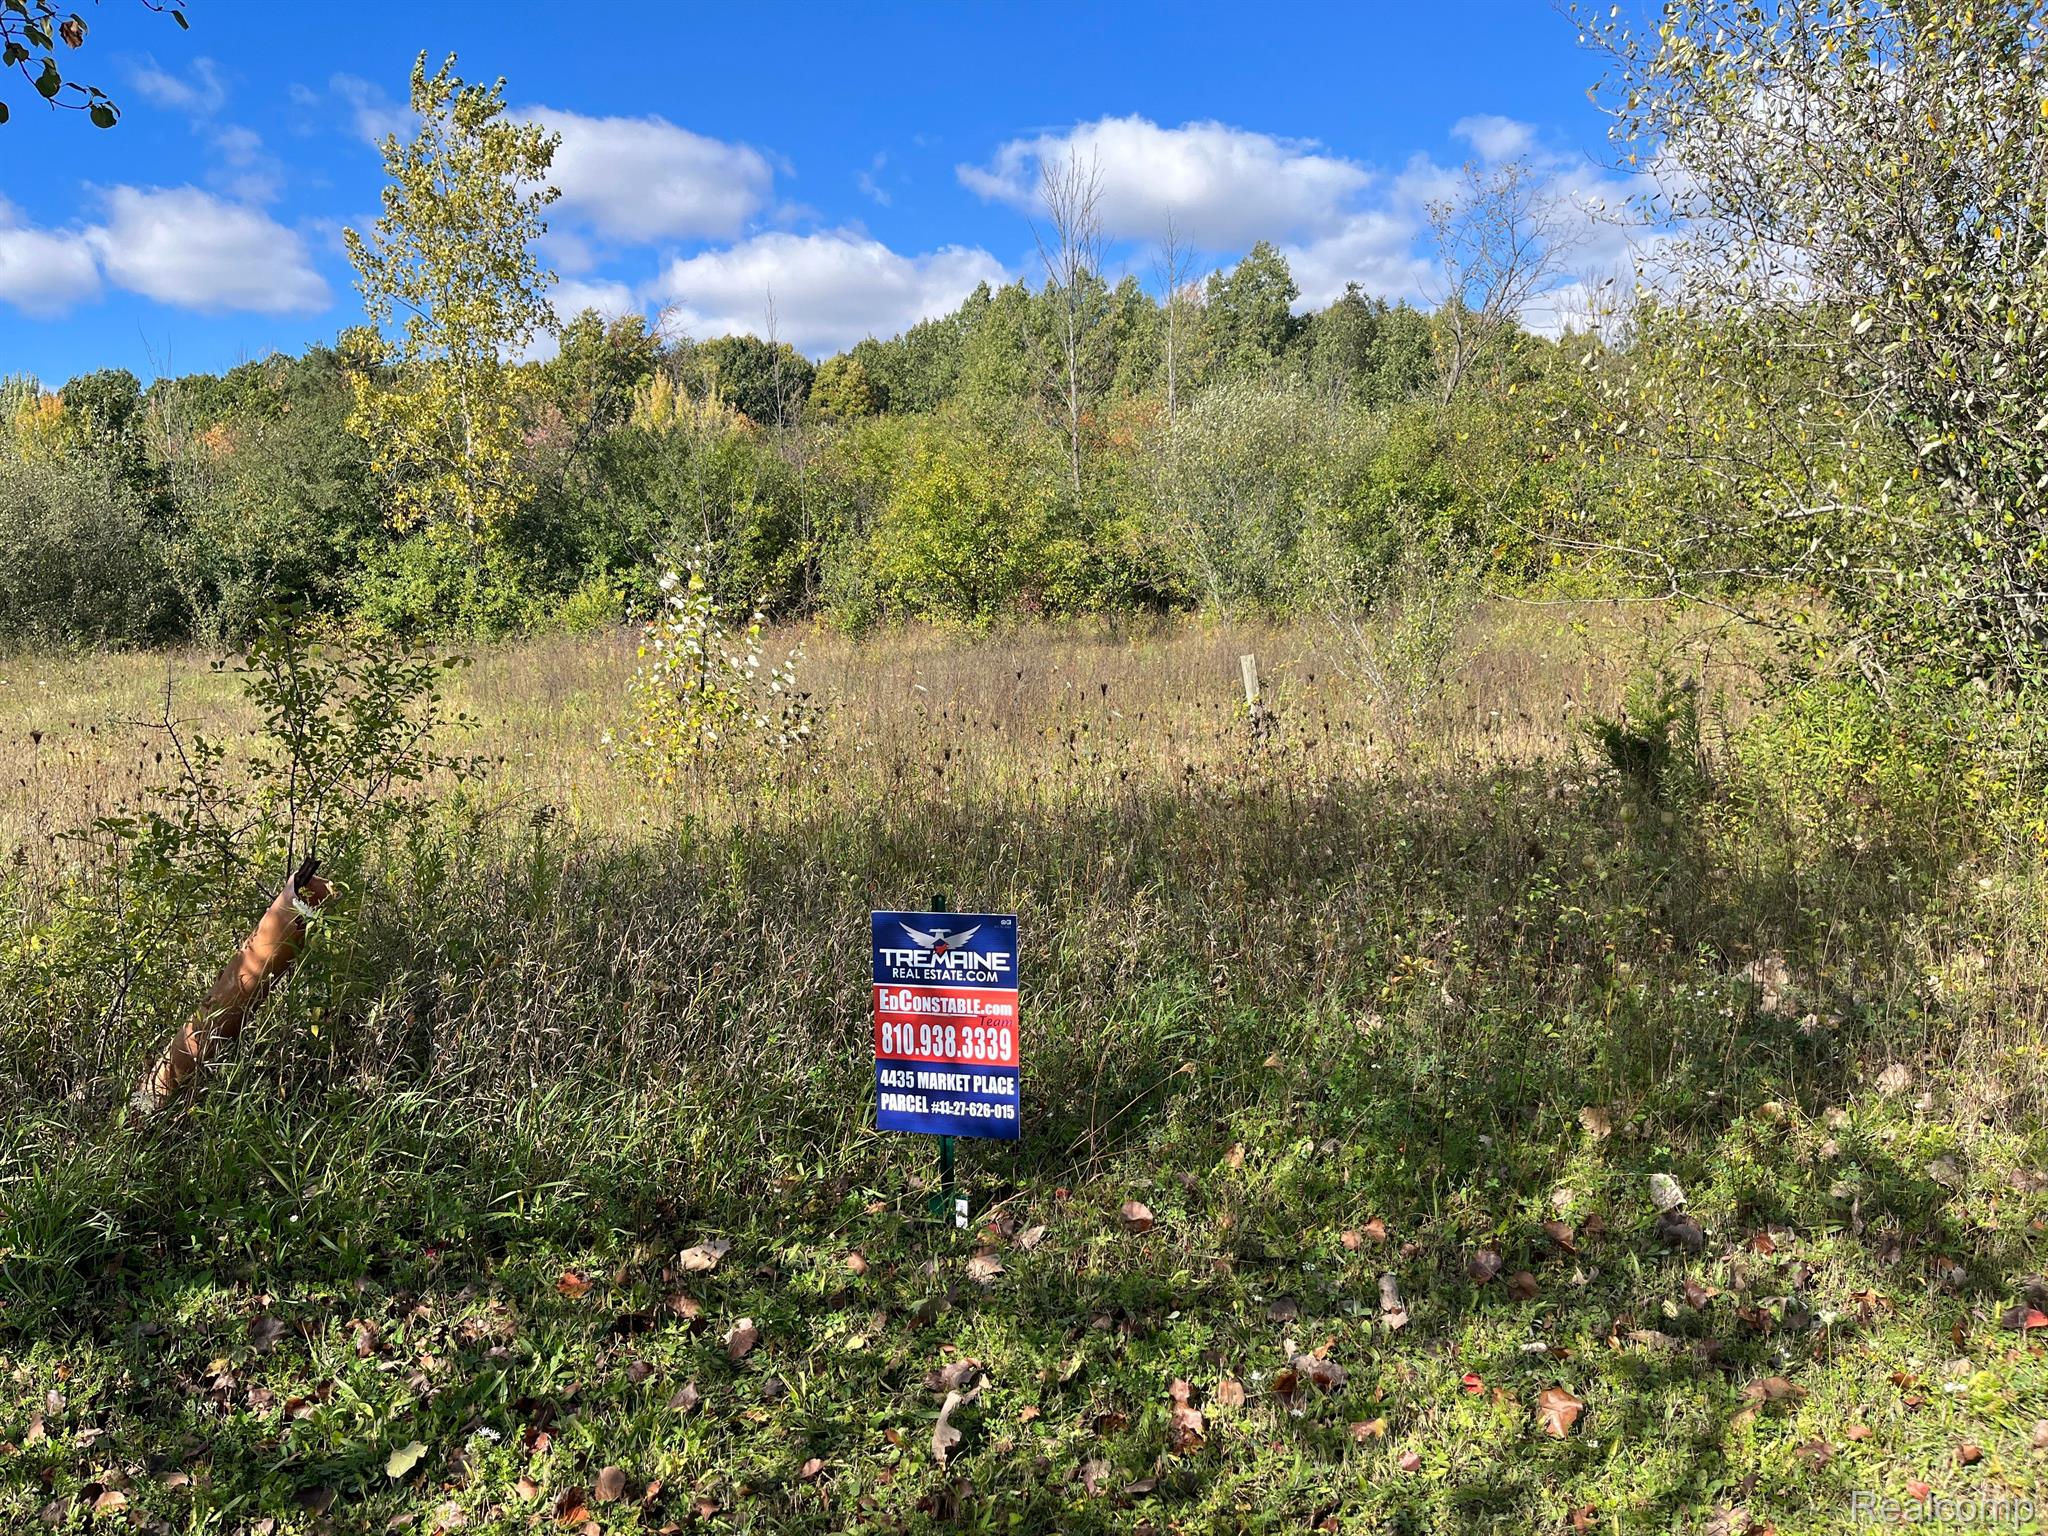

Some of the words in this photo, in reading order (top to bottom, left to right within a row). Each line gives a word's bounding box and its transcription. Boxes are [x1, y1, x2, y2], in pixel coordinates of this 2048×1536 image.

[879, 948, 1010, 971] TREMAINE
[892, 967, 920, 979] REAL
[924, 969, 998, 982] ESTATE.COM
[979, 1015, 1012, 1027] Team
[882, 1022, 1011, 1061] 810.938.3339
[880, 1069, 914, 1088] 4435
[918, 1072, 971, 1092] MARKET
[973, 1076, 1014, 1095] PLACE
[881, 1093, 928, 1113] PARCEL
